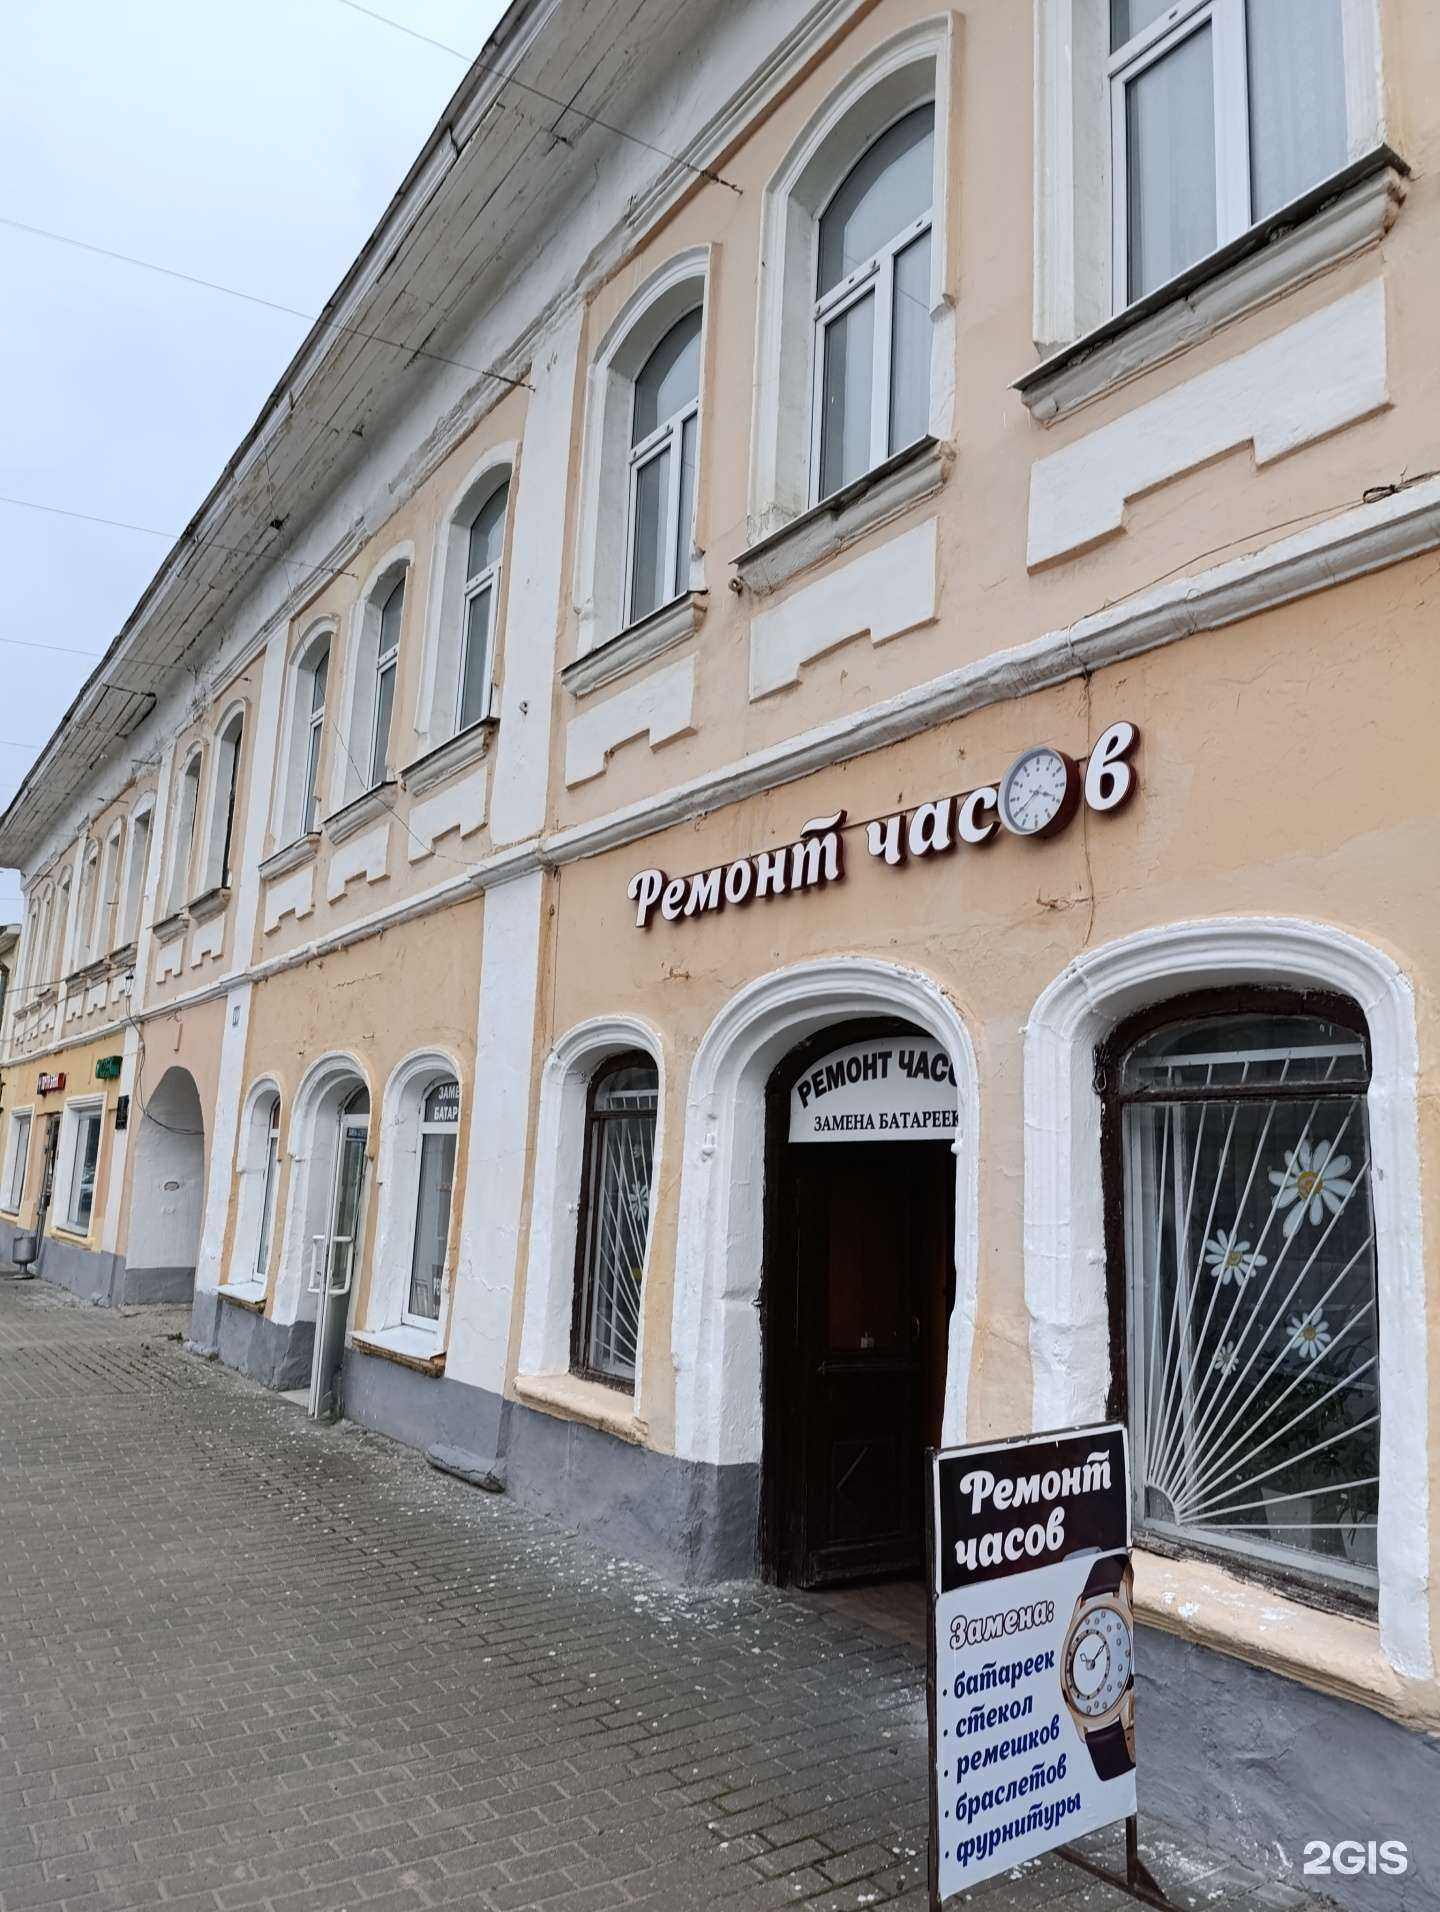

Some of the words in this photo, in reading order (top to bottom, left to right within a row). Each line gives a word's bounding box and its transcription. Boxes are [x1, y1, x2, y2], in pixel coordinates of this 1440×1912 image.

[627, 808, 847, 928] Ремонт
[797, 1050, 893, 1109] РЕМОНТ
[813, 1113, 876, 1132] ЗАМЕНА
[959, 1449, 1112, 1516] Ремонт
[954, 1505, 1066, 1572] часов
[949, 1600, 1055, 1651] Замена:
[953, 1649, 1056, 1700] батареек
[955, 1694, 1034, 1739] стекол
[956, 1713, 1061, 1784] ремешков
[955, 1752, 1068, 1824] браслетов
[956, 1792, 1082, 1868] фурнитуры
